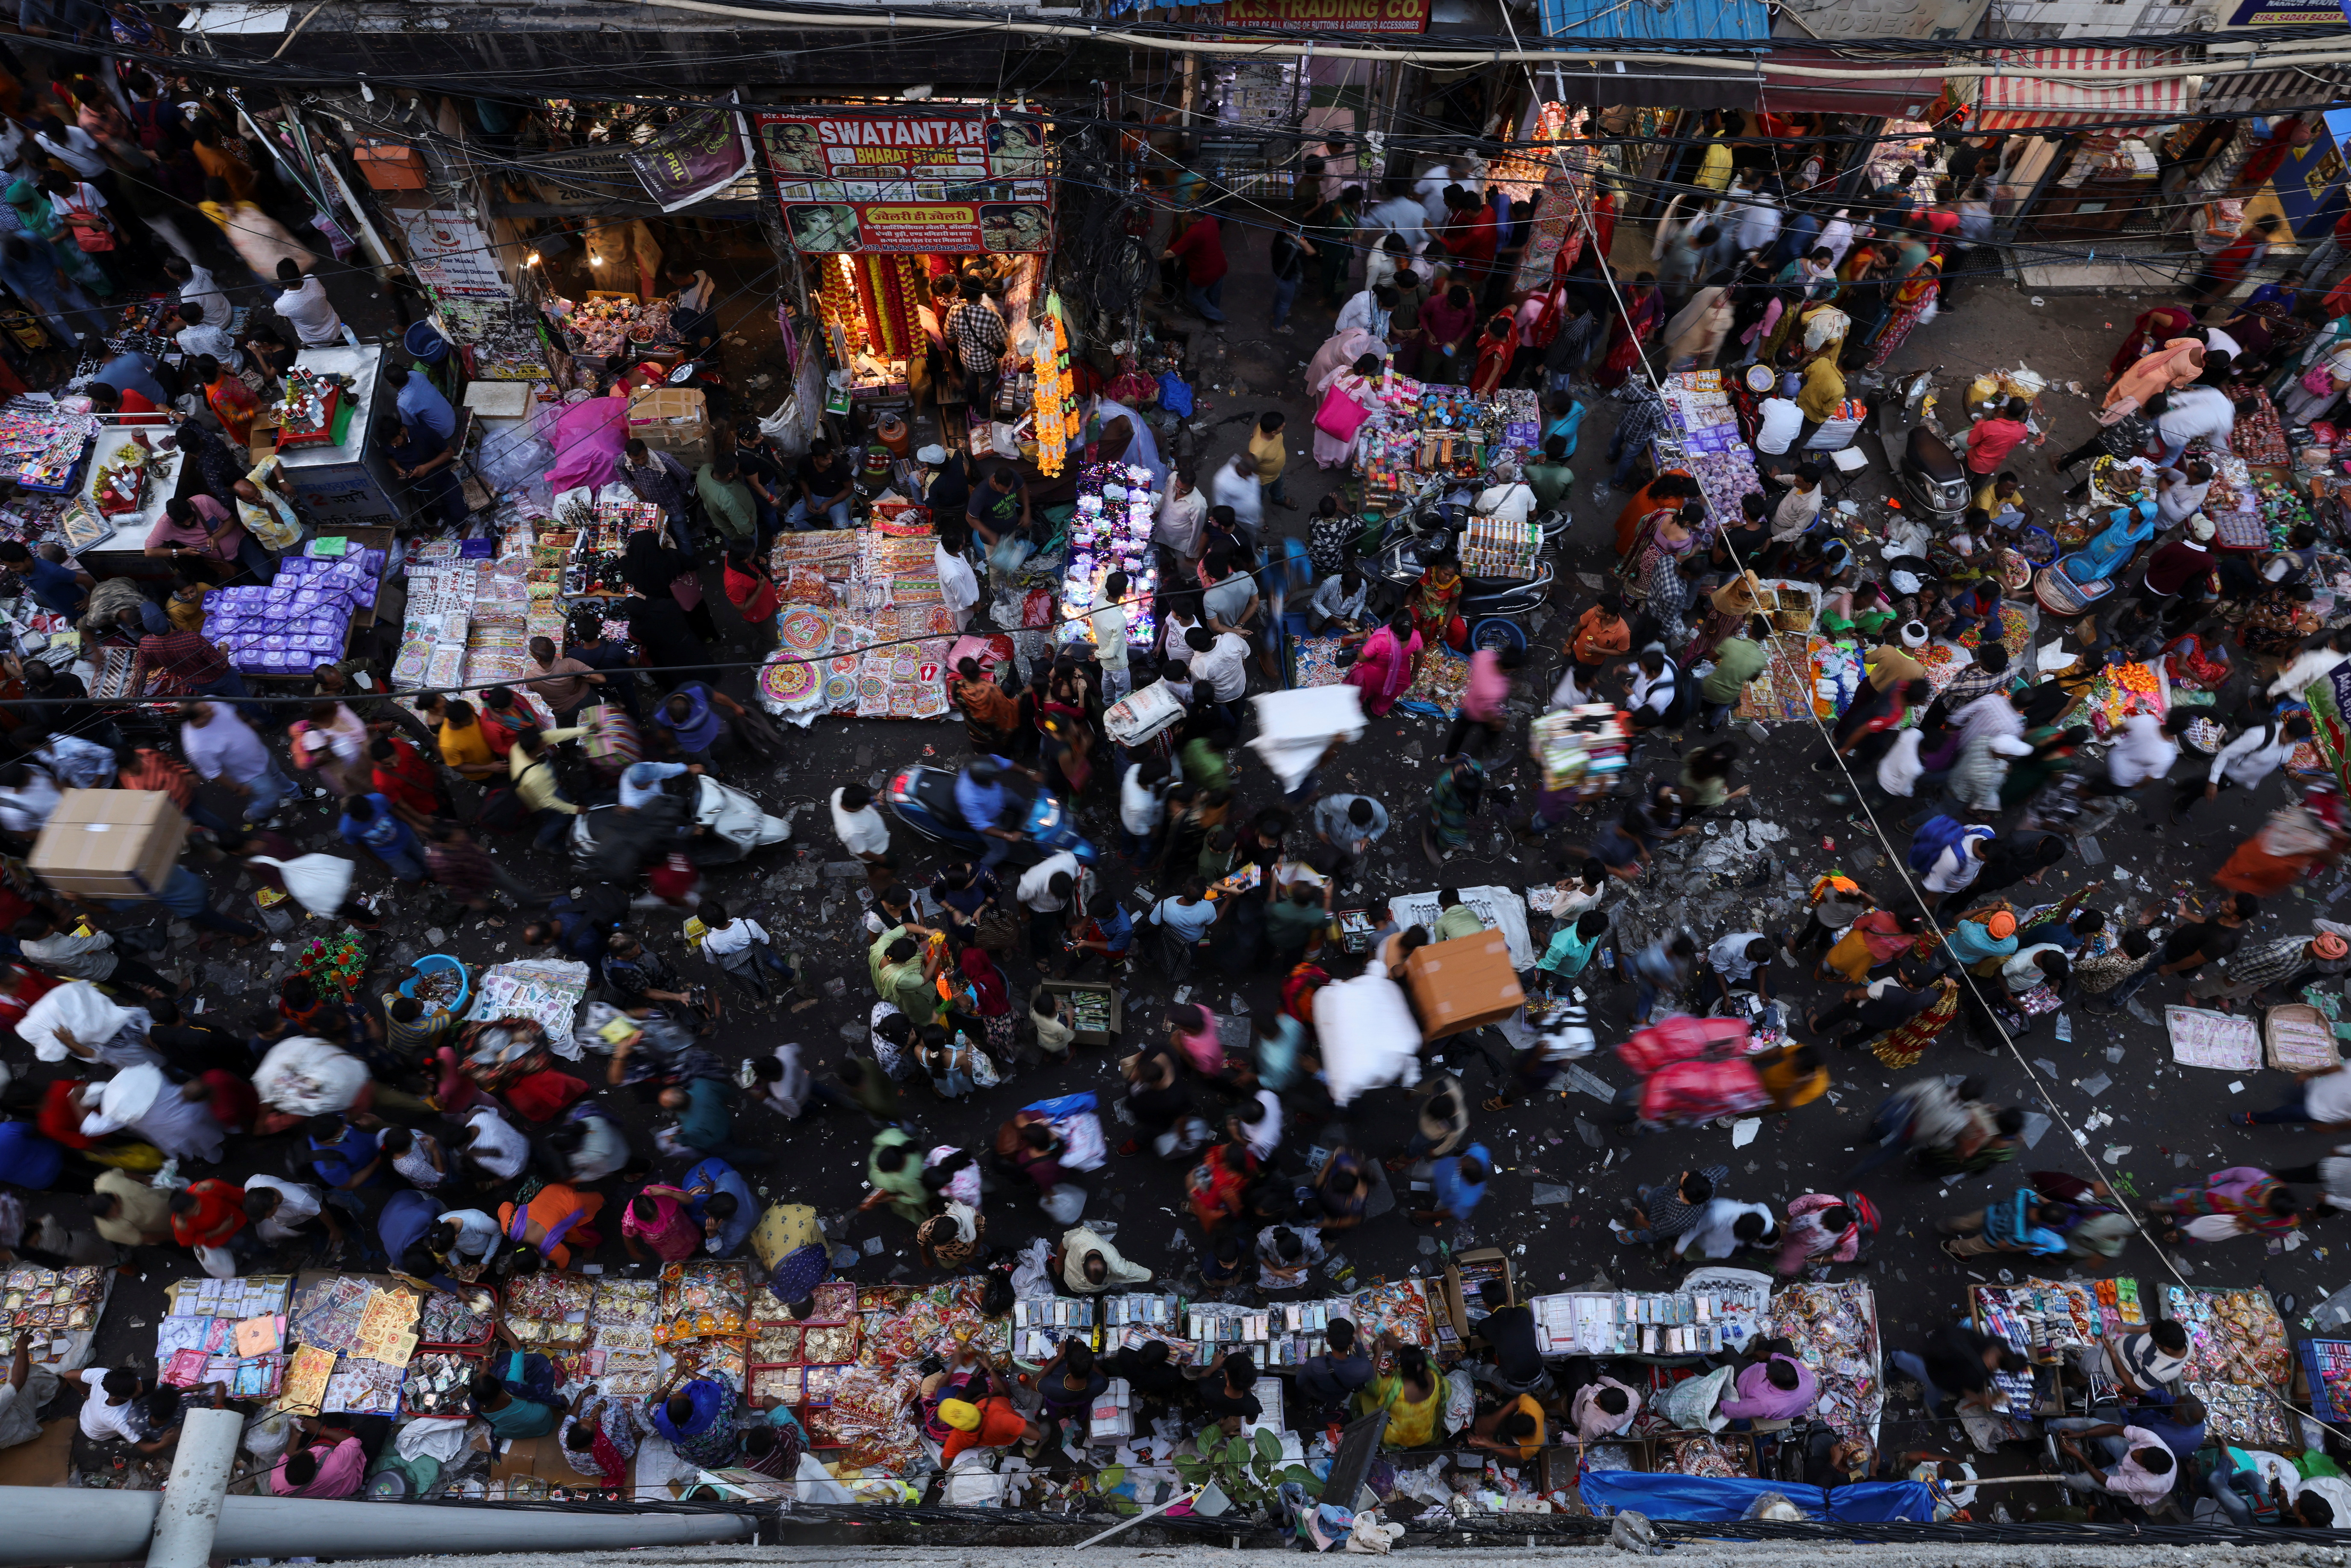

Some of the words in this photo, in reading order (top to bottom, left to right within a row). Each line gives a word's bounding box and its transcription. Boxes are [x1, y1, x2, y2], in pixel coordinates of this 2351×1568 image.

[1231, 0, 1274, 18] K.S.
[1276, 0, 1379, 18] TRADING
[1387, 0, 1423, 18] CO.
[1283, 21, 1301, 29] KINDS
[1311, 21, 1339, 29] BUTTONS
[1340, 21, 1345, 29] &
[1346, 21, 1378, 29] GARMENTS
[1379, 21, 1419, 29] ACCESSORIES
[1815, 14, 1935, 35] HOSIERY
[819, 121, 985, 145] SWATANTAR
[662, 148, 685, 181] APRIL
[855, 147, 907, 164] BHARAT
[912, 147, 957, 164] STORE
[913, 212, 926, 220] ही
[308, 493, 328, 506] 2
[992, 499, 1005, 512] BIKE
[1005, 492, 1017, 502] HIKE
